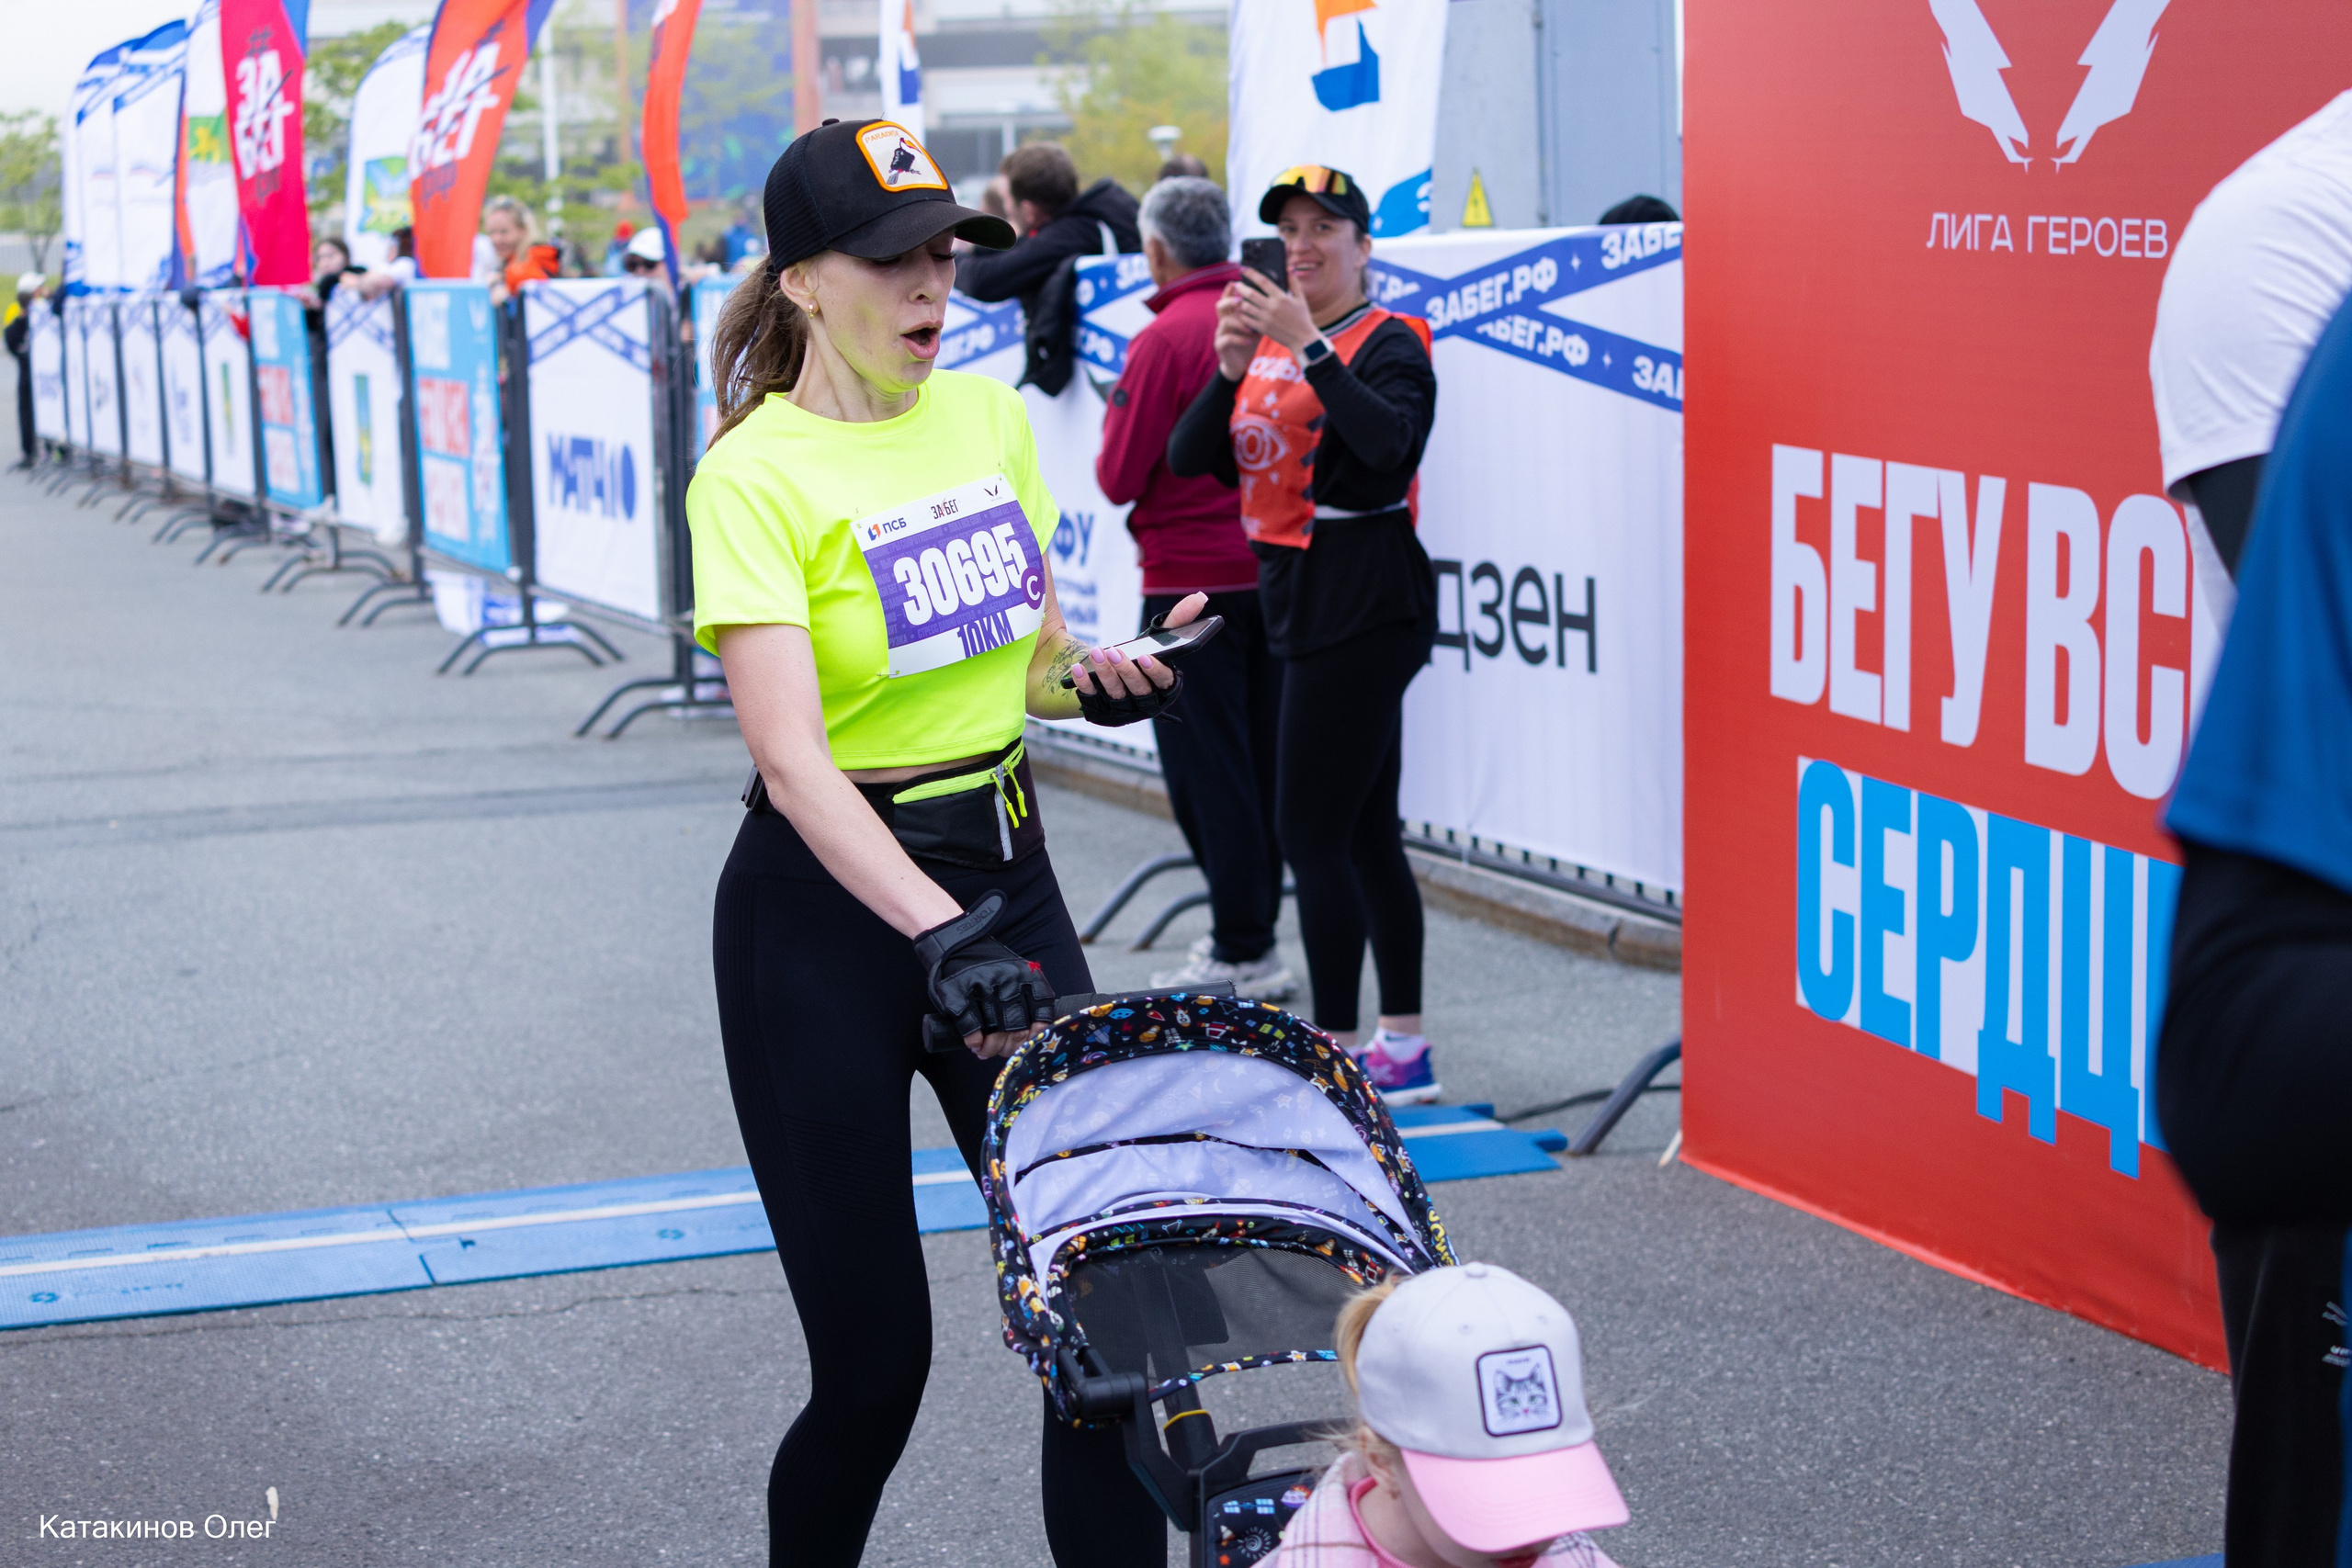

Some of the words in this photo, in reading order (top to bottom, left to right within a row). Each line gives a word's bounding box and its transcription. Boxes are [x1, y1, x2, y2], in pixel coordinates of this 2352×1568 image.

[1927, 212, 2015, 252] ЛИГА
[2026, 216, 2169, 258] ГЕРОЕВ
[1426, 257, 1558, 331] ЗАБЕГ.РФ
[882, 517, 907, 534] ПСБ
[892, 521, 1029, 626] 30695
[1770, 443, 2007, 748] БЕГУ
[2025, 482, 2220, 800] ВС
